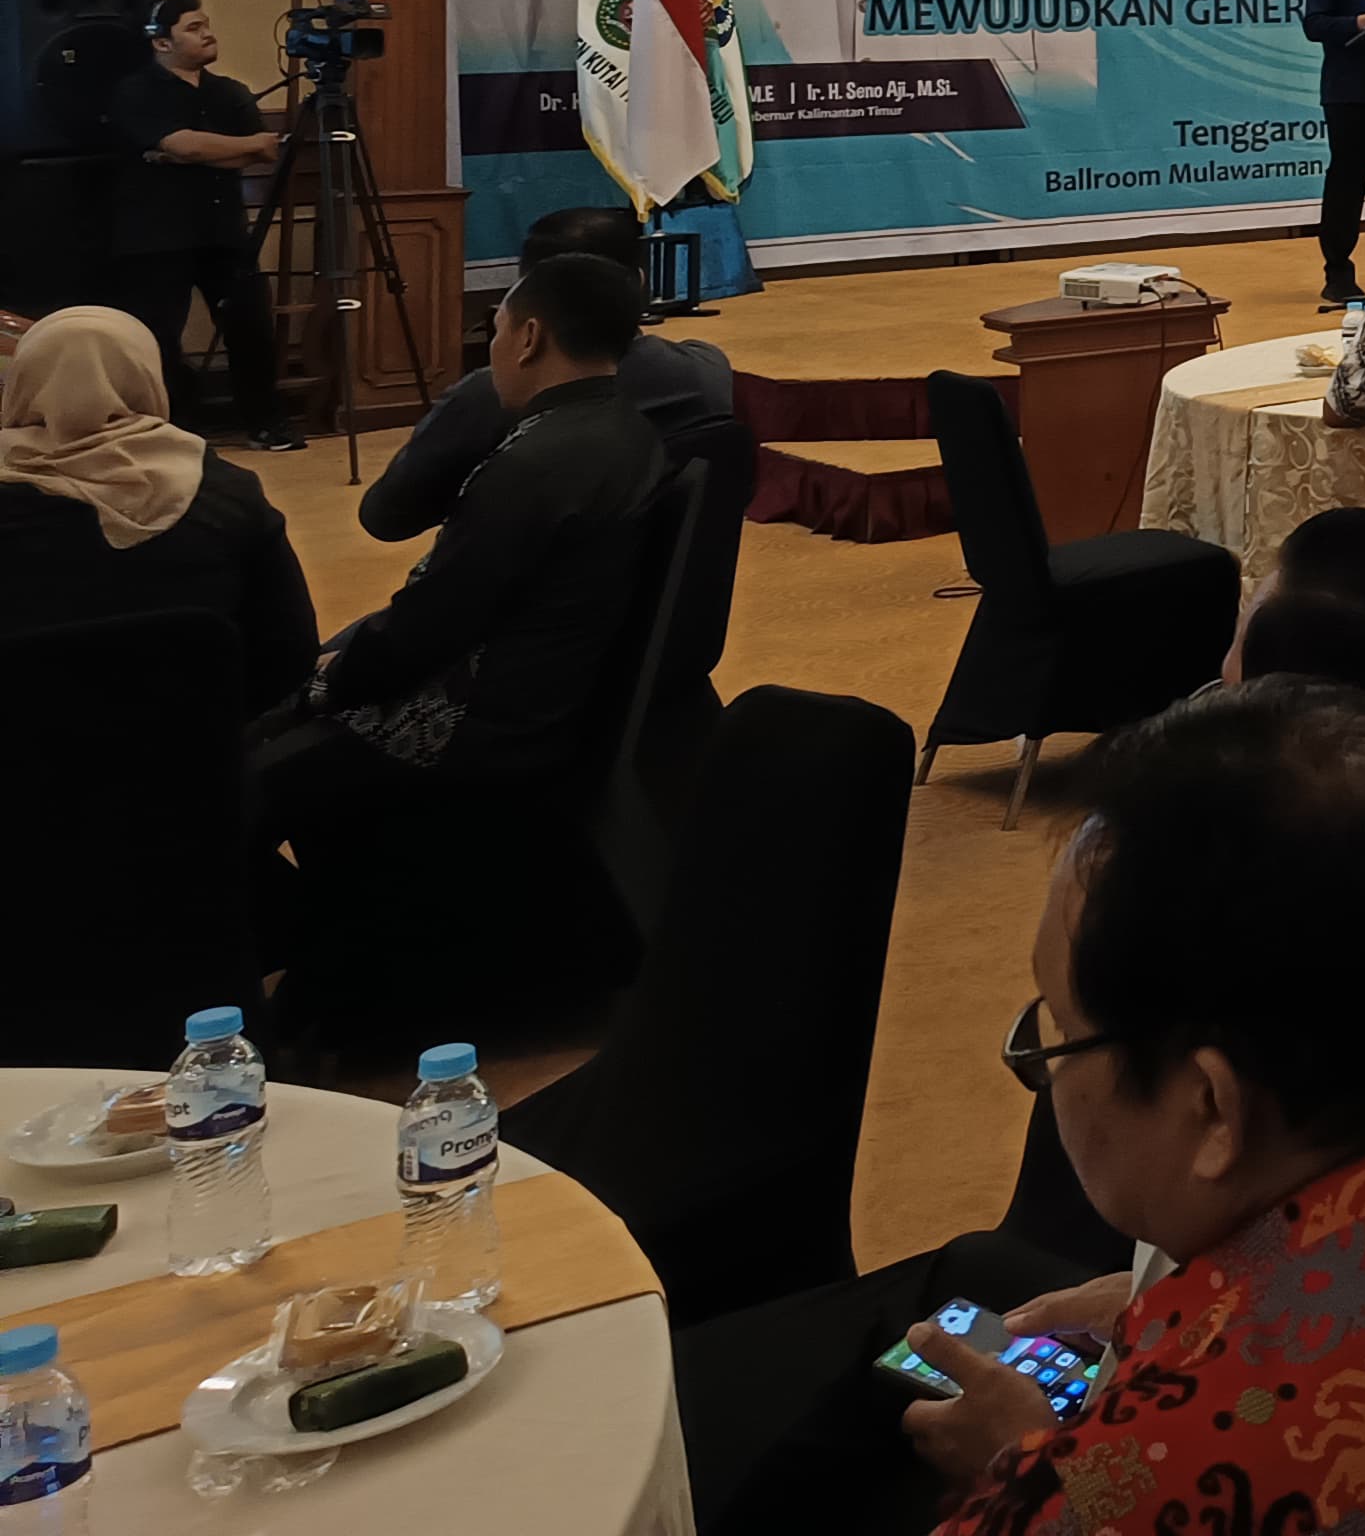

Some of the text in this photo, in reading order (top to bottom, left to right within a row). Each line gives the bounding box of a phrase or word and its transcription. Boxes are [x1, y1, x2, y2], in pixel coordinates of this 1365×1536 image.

[541, 93, 566, 111] Dr.
[807, 83, 824, 101] Ir.
[829, 82, 843, 99] H.
[846, 82, 883, 99] Seno
[798, 107, 864, 120] Kalimantan
[867, 105, 903, 117] Timur
[1045, 167, 1161, 193] Ballroom
[441, 1126, 497, 1156] Promp
